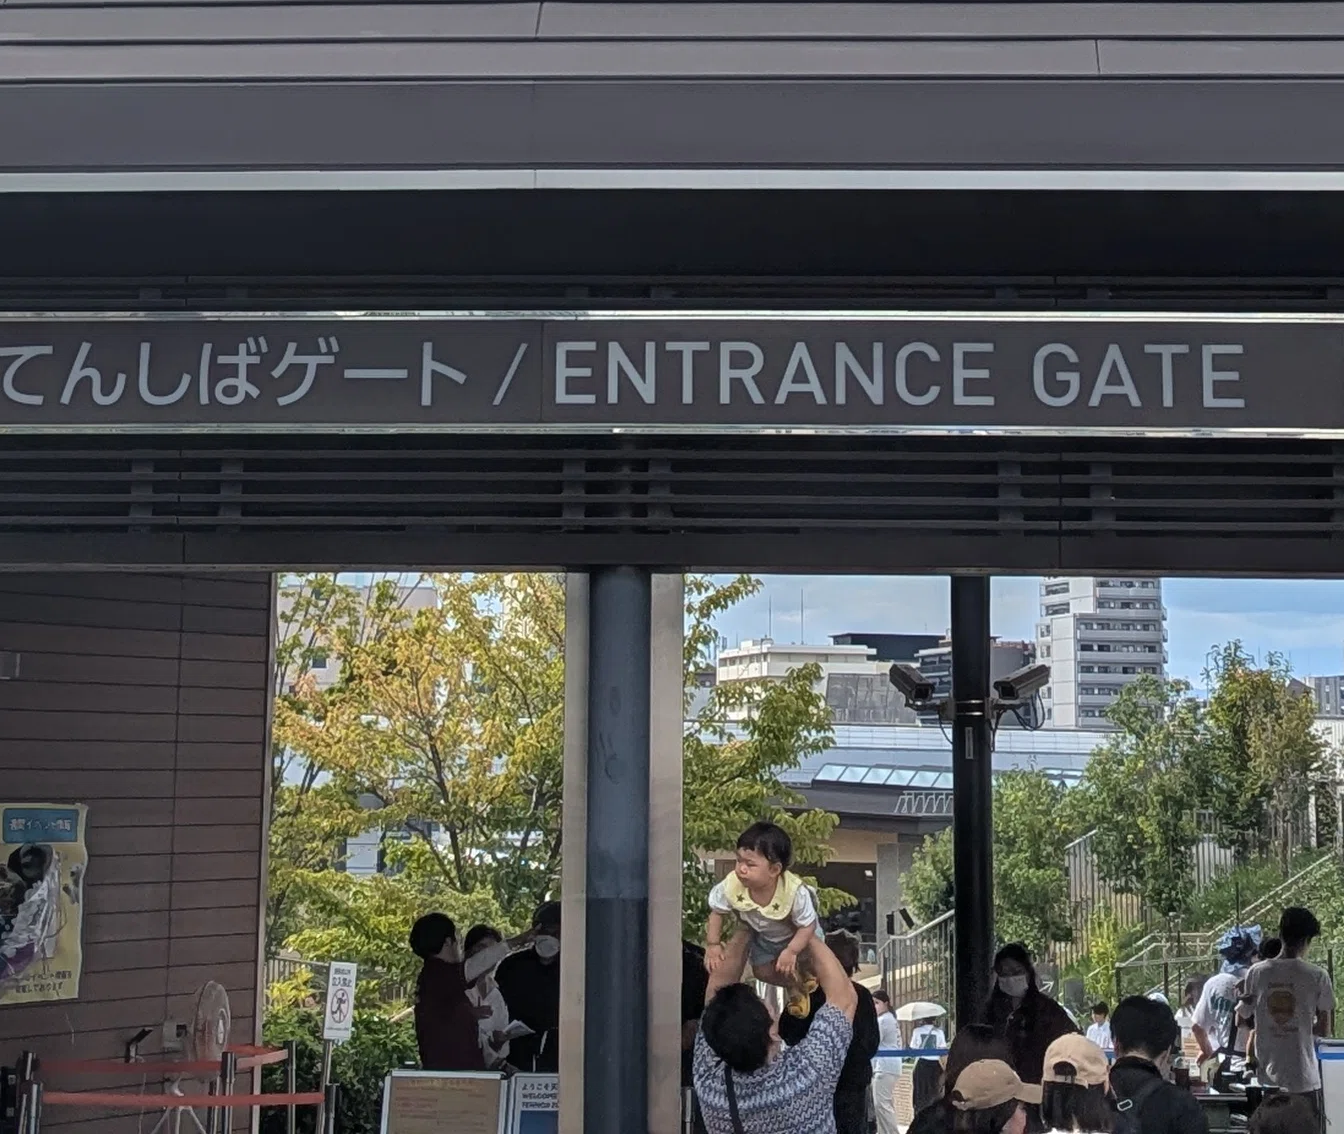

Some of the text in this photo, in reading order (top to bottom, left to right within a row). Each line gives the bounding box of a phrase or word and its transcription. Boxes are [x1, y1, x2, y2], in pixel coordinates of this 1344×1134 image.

[492, 342, 528, 406] /
[555, 341, 996, 407] ENTRANCE
[1031, 342, 1246, 409] GATE
